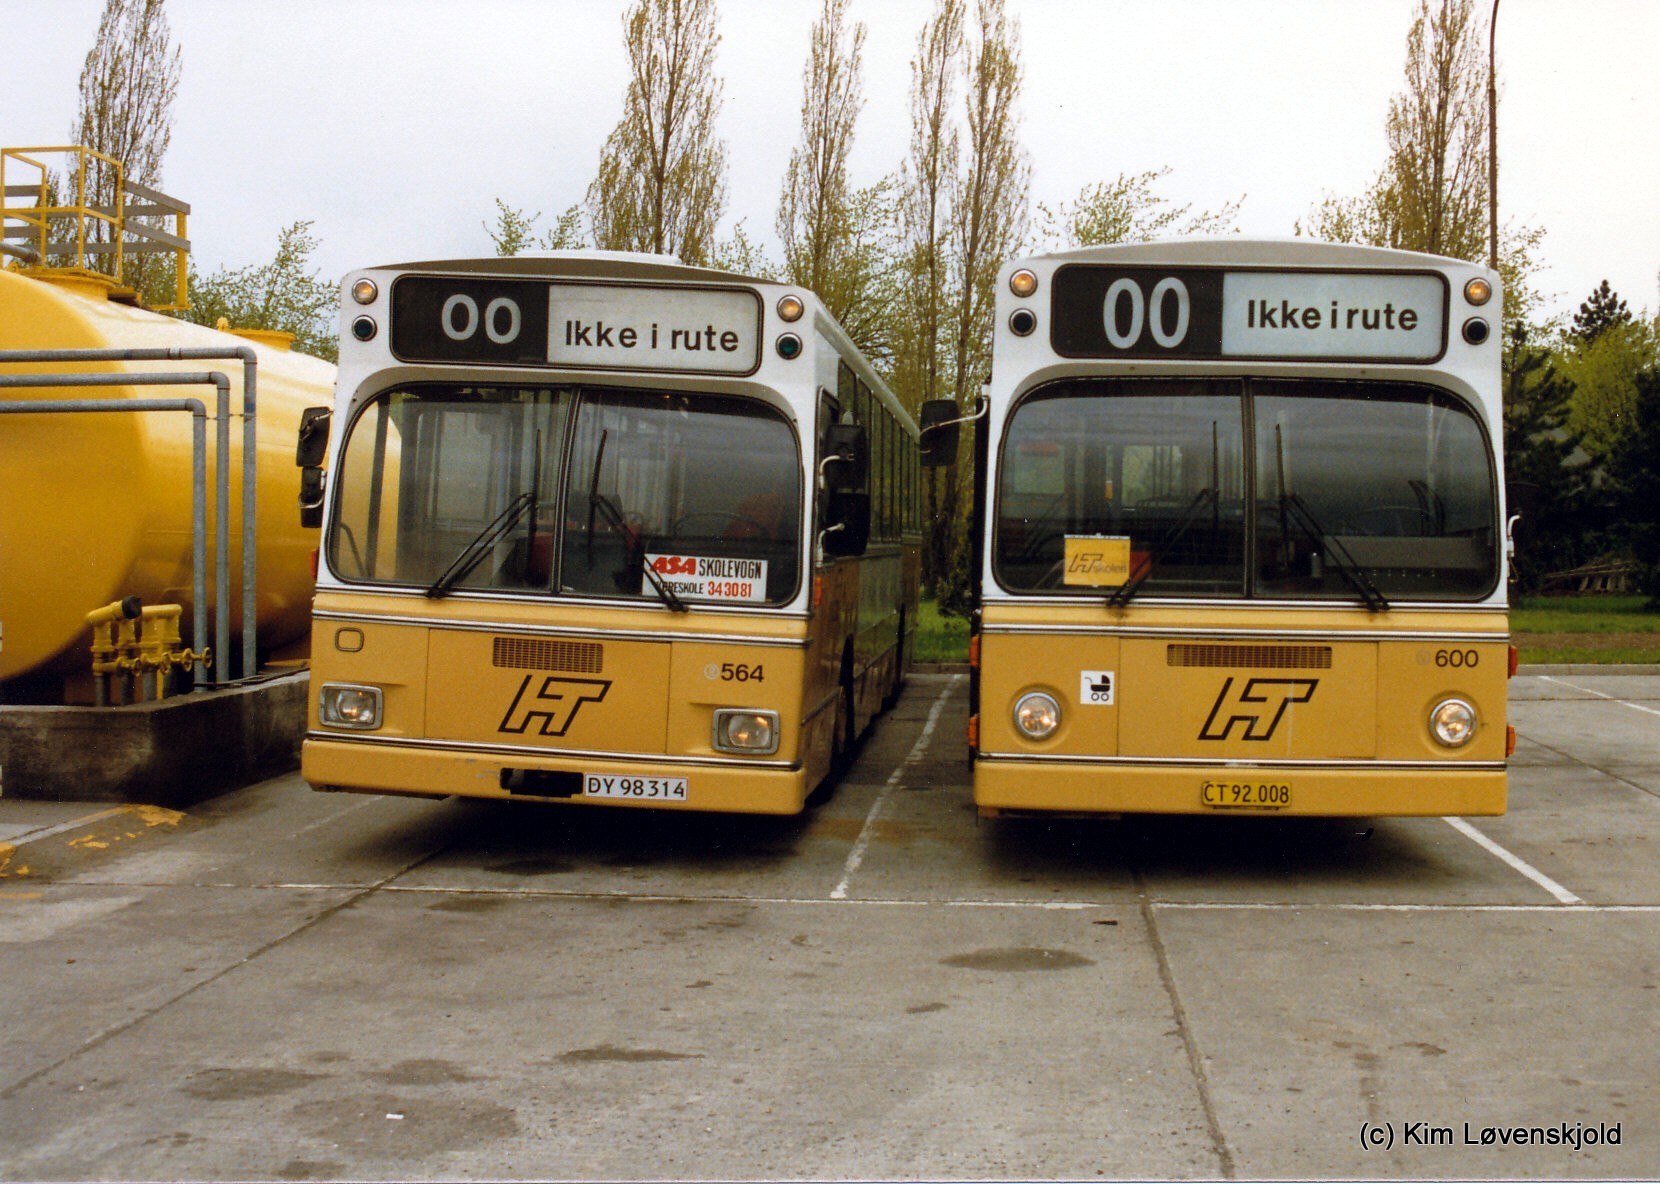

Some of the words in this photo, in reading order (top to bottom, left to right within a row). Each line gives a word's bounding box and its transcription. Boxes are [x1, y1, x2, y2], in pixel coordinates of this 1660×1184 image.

[1247, 300, 1322, 330] Ikke
[1331, 301, 1338, 329] i
[1346, 303, 1419, 331] rute
[565, 319, 638, 349] Ikke
[650, 323, 658, 350] i
[671, 325, 739, 352] rute
[650, 557, 696, 575] ASA
[699, 558, 762, 580] SKOLEVOGN
[1435, 649, 1479, 668] 600
[721, 663, 765, 683] 564
[588, 777, 615, 794] DY
